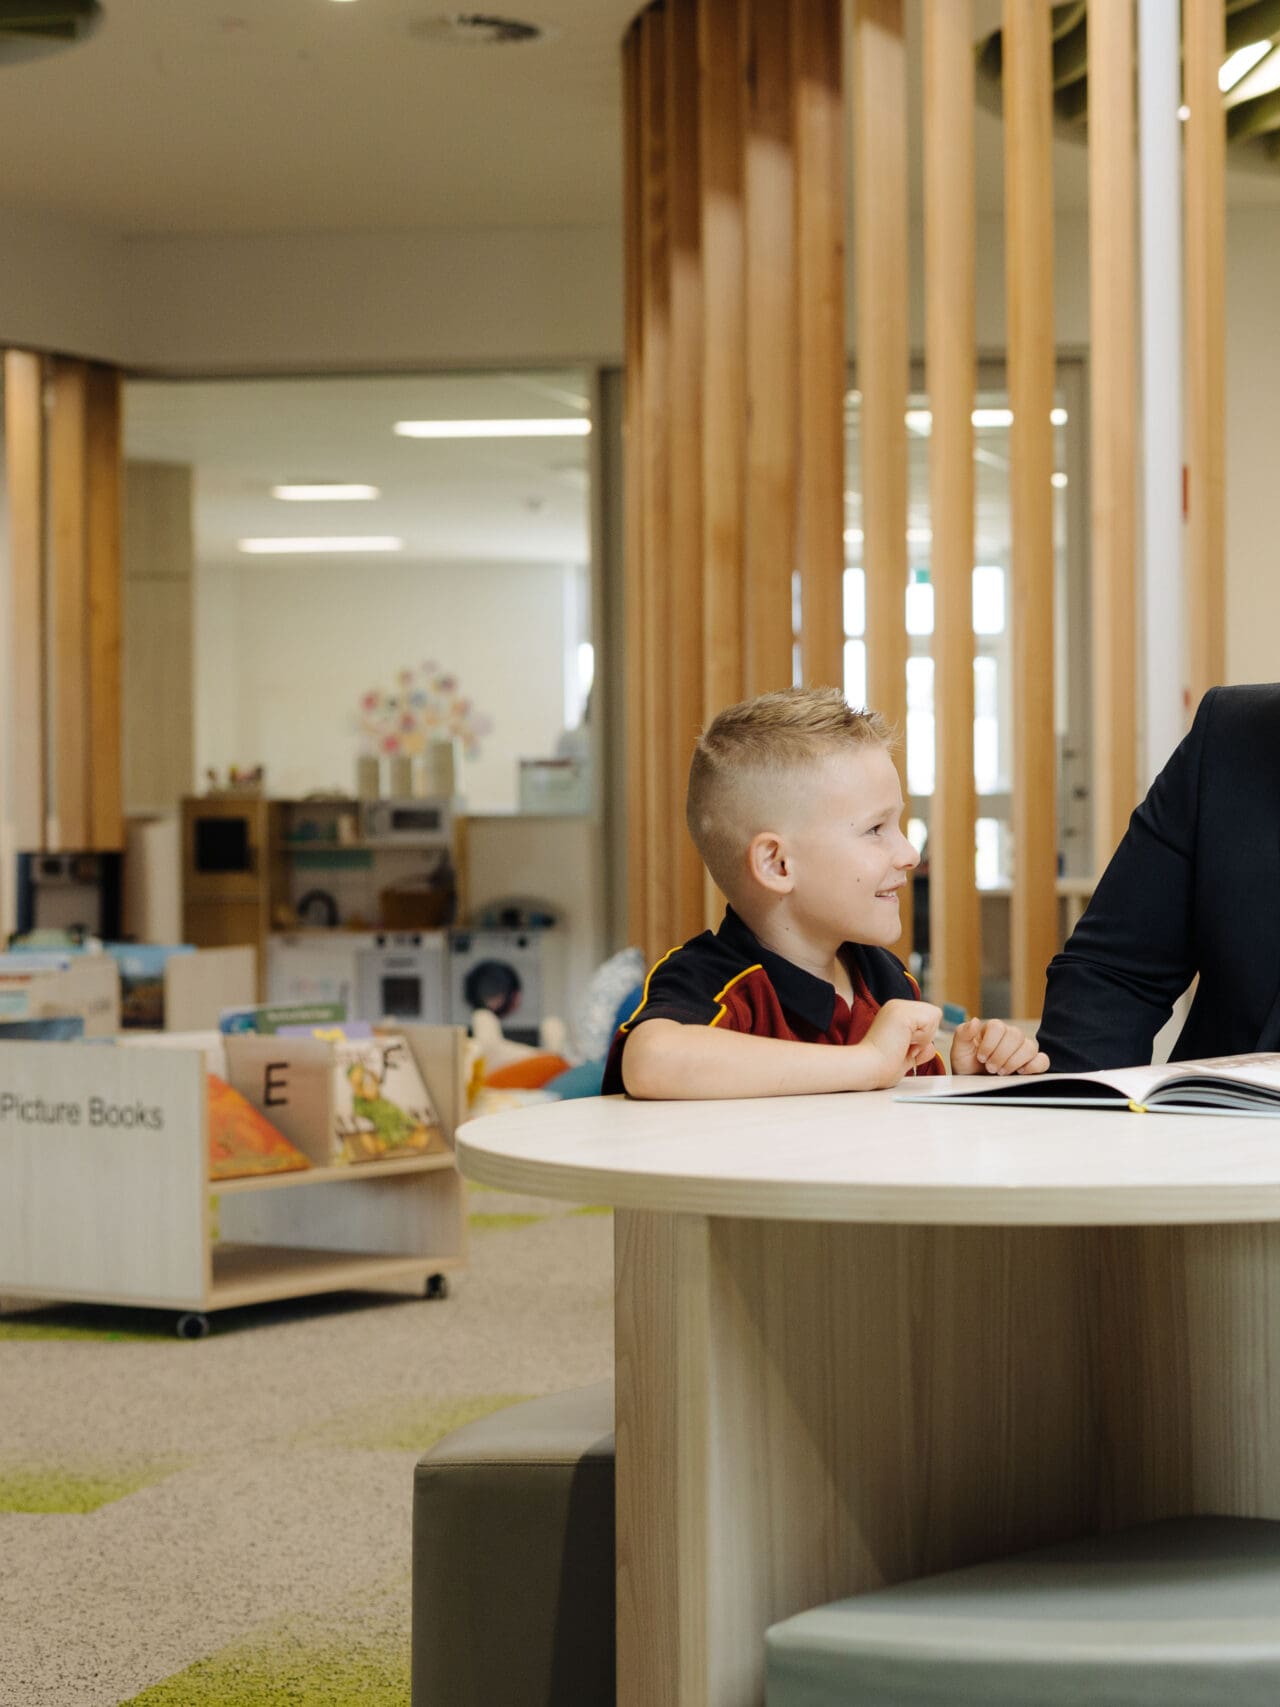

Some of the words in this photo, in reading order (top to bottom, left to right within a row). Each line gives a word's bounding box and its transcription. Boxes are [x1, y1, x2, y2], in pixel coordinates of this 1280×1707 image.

[263, 1061, 290, 1107] E
[0, 1092, 81, 1126] Picture
[88, 1096, 165, 1131] Books
